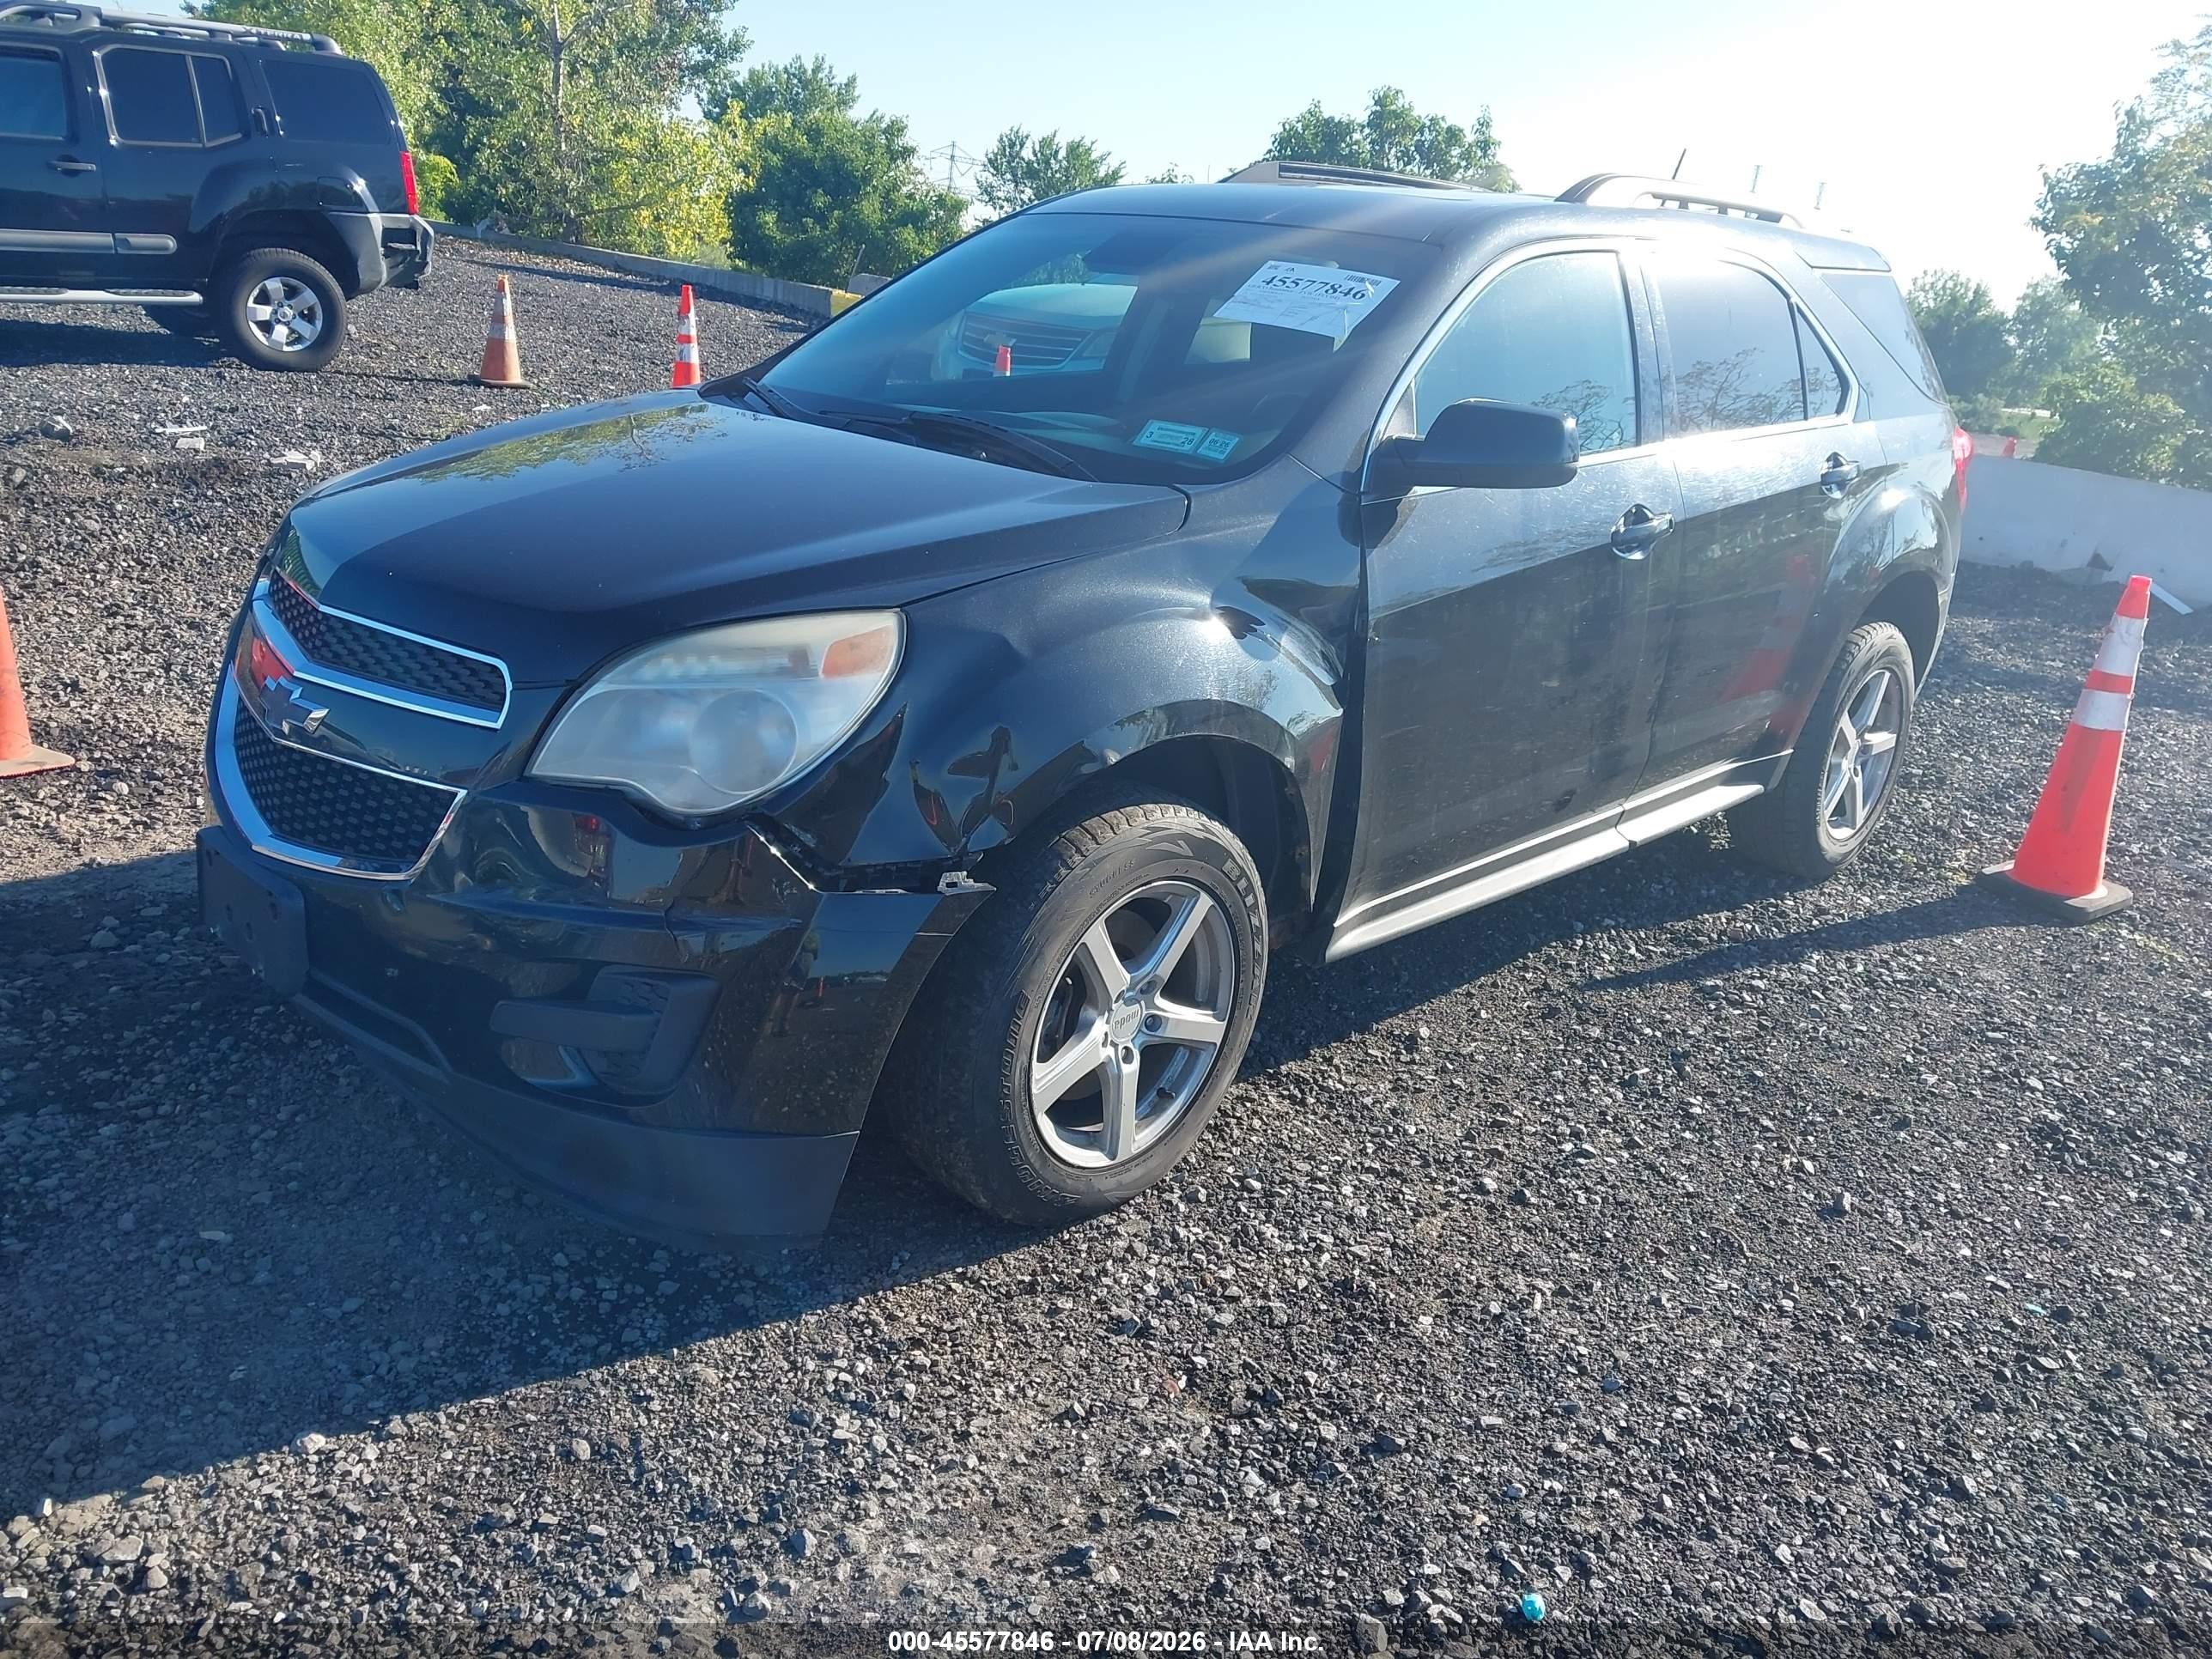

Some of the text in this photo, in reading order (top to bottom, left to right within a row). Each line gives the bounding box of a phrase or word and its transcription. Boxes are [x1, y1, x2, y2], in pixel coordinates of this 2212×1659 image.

[1261, 275, 1369, 300] 45577846
[1182, 437, 1194, 446] 28
[1222, 858, 1264, 1020] BLIZZAK
[1114, 1008, 1139, 1030] moda
[1000, 989, 1081, 1206] BRIDGESTONE
